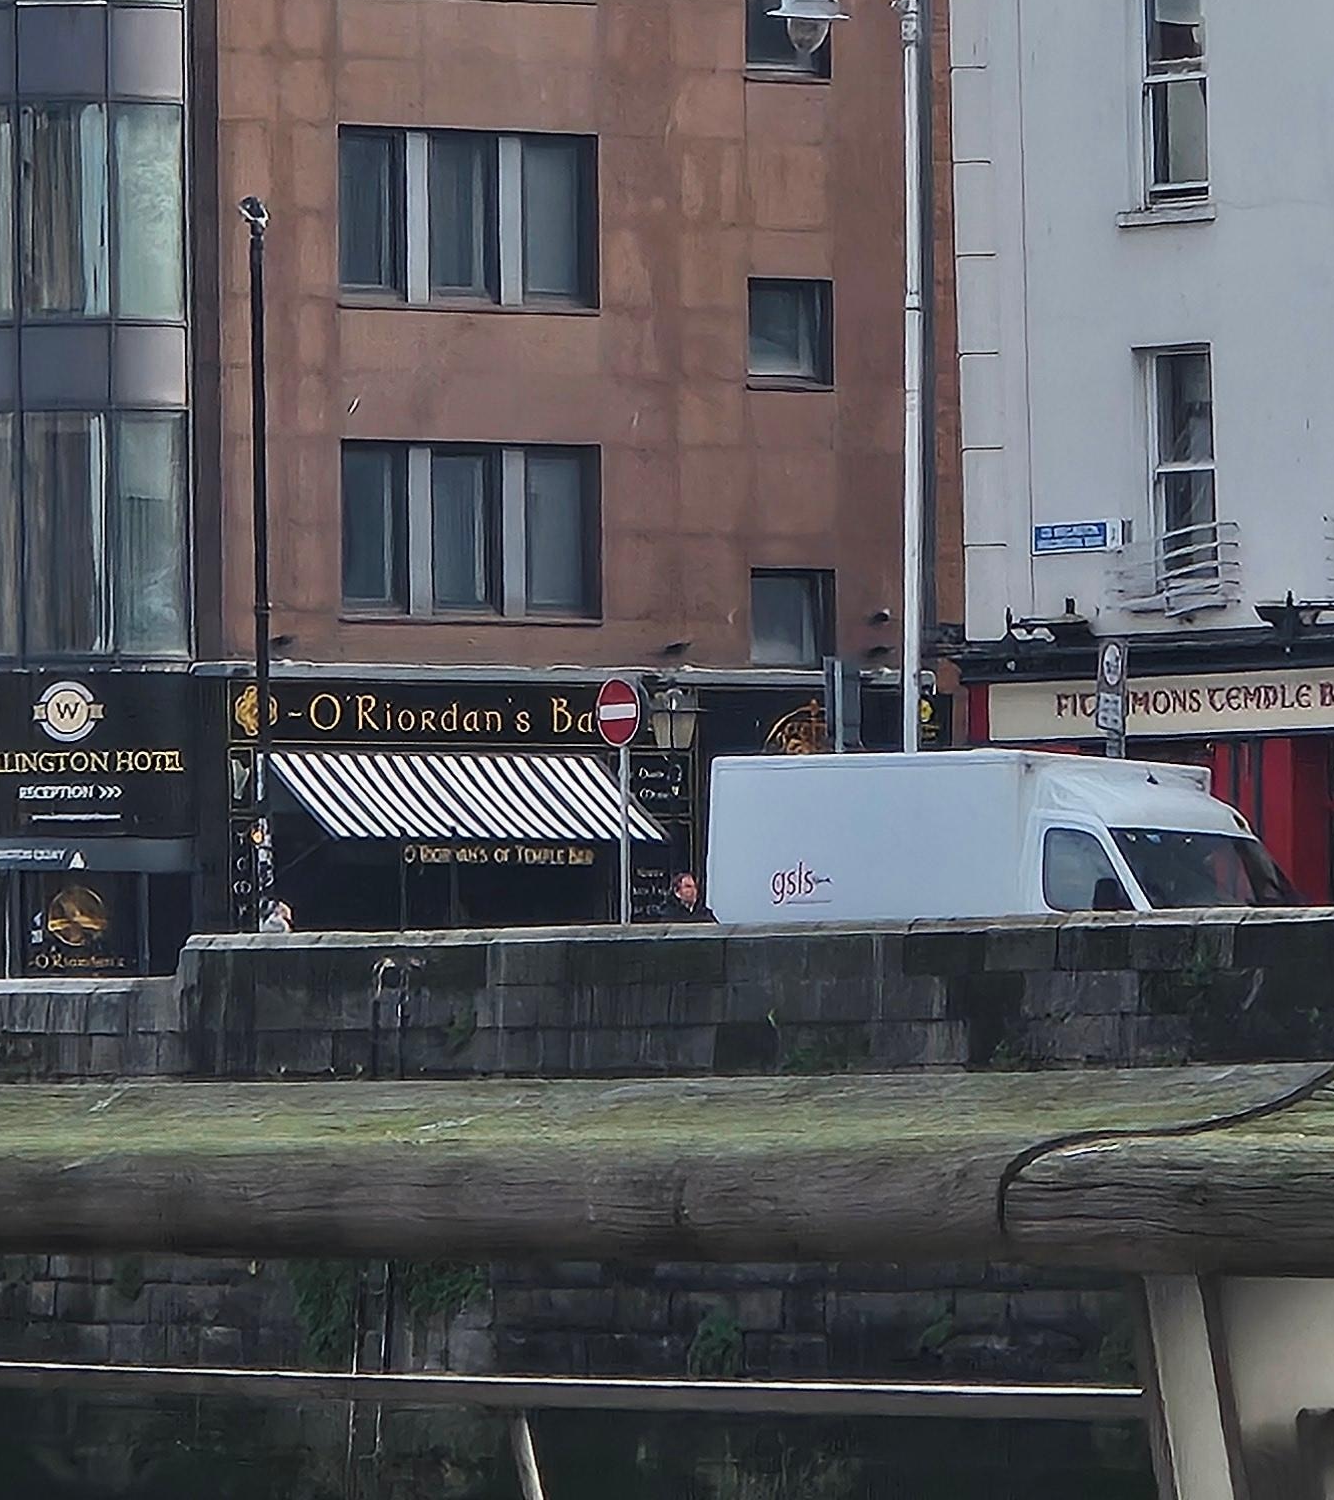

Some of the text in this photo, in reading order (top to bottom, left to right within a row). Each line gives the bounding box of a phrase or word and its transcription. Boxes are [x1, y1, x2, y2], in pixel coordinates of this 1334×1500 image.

[56, 702, 80, 719] W
[550, 697, 595, 733] Ba
[1055, 688, 1202, 717] FITIMONS
[116, 750, 184, 771] HOTEL
[771, 860, 814, 904] gsls
